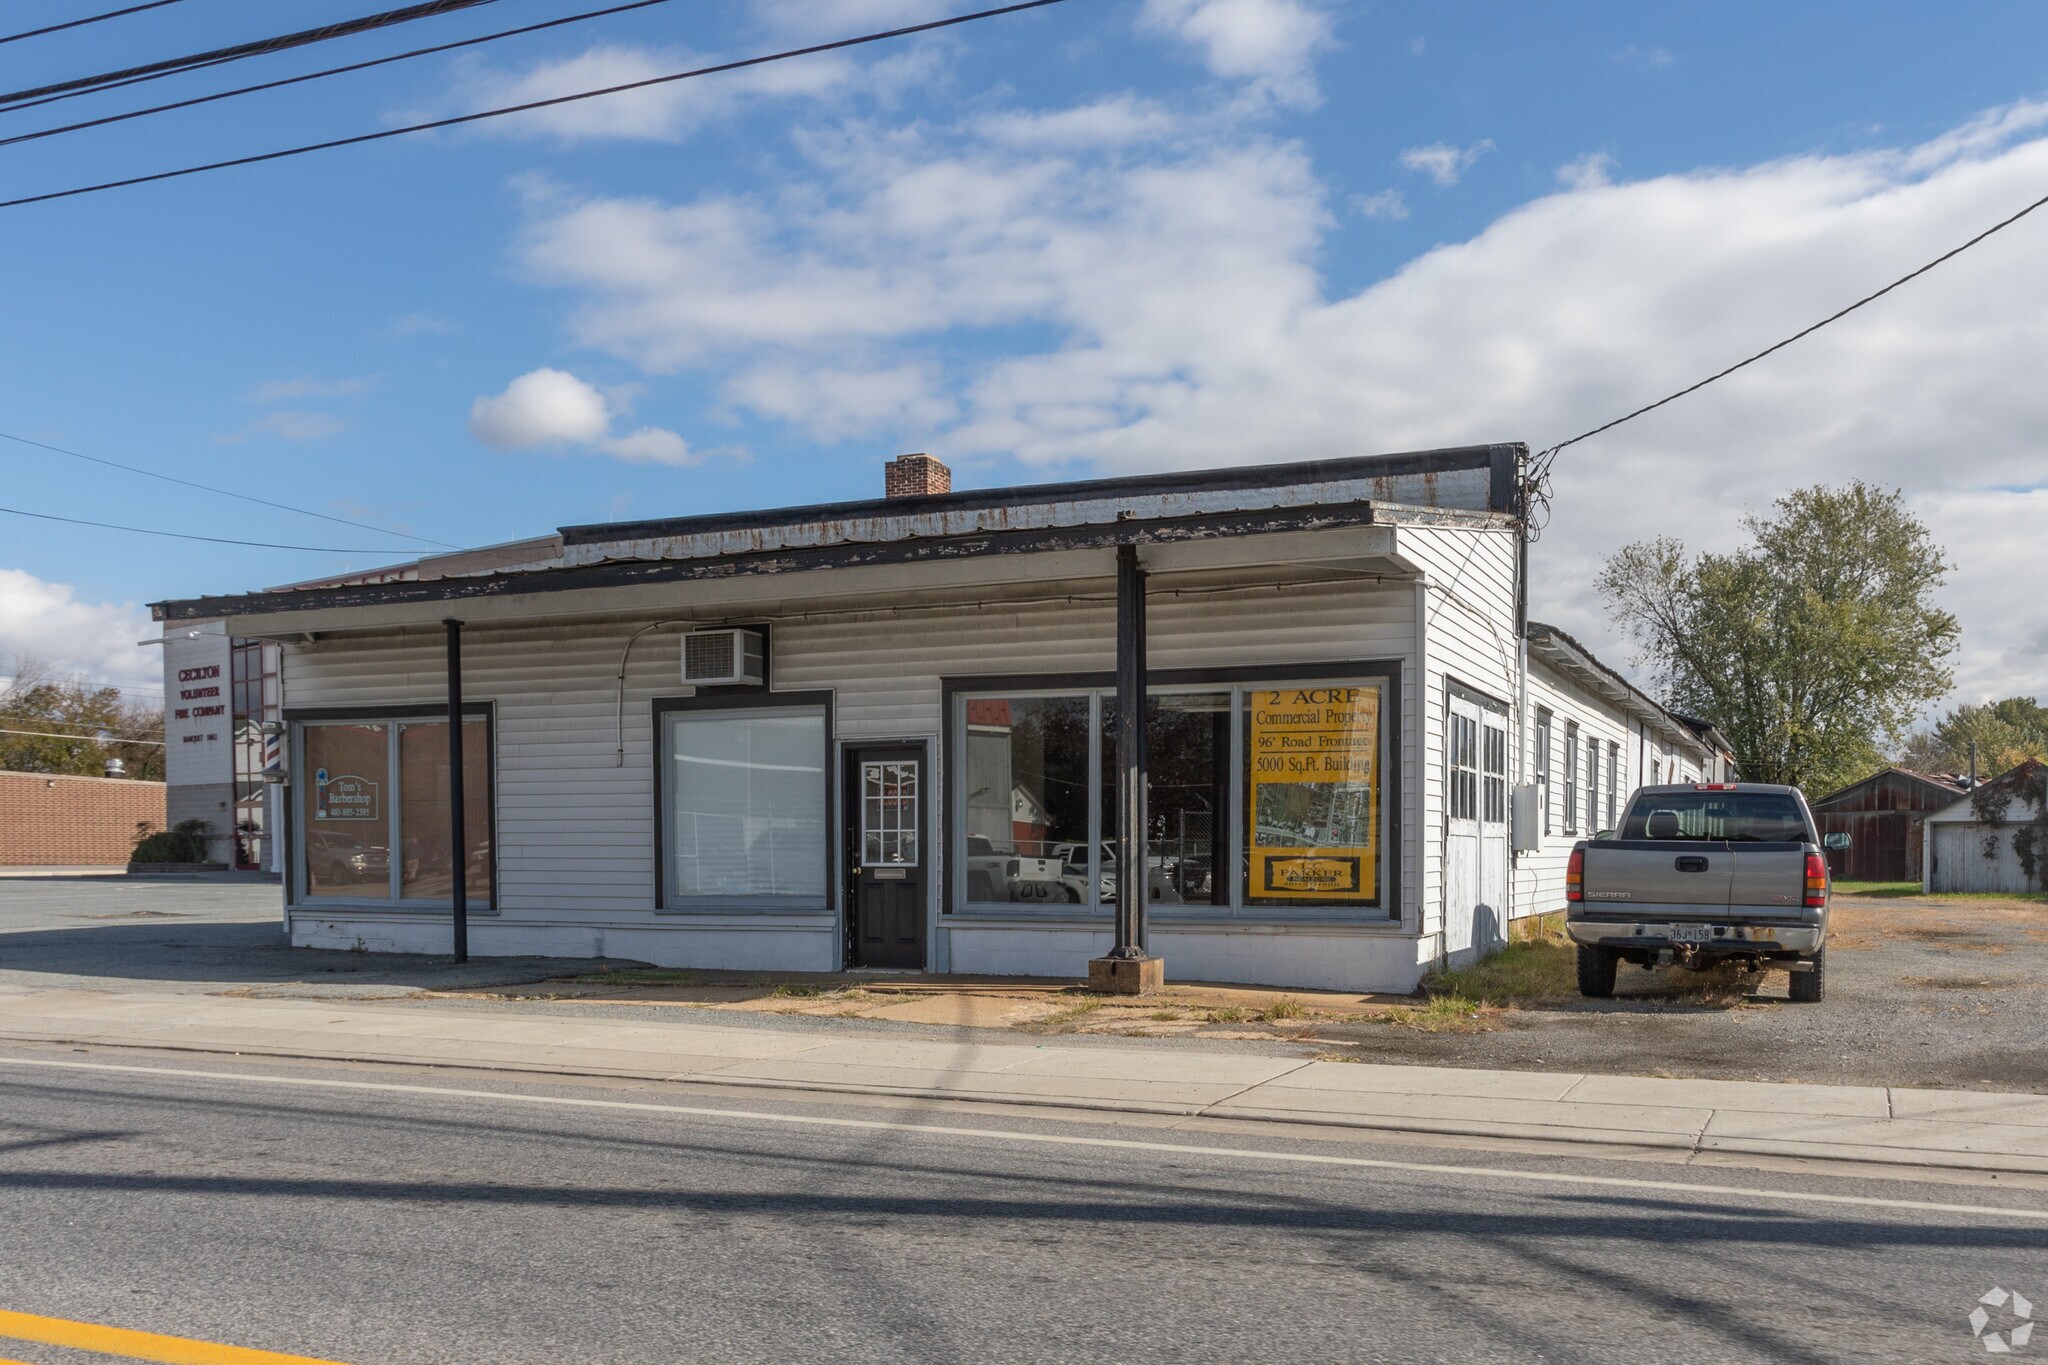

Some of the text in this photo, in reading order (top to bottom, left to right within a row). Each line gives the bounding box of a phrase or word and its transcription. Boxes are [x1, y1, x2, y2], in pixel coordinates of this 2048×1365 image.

[178, 665, 220, 682] CECILTON
[180, 686, 220, 700] VOLUNTEER
[1268, 687, 1361, 705] 2 ACRE
[175, 705, 225, 719] FIRE COMPANY
[1256, 709, 1320, 725] Commercial
[1282, 736, 1312, 747] Road
[1256, 757, 1284, 772] 5000
[1324, 756, 1370, 774] Building
[338, 781, 362, 792] Tom's
[329, 792, 371, 805] Barbershop
[1280, 869, 1344, 877] PARKER
